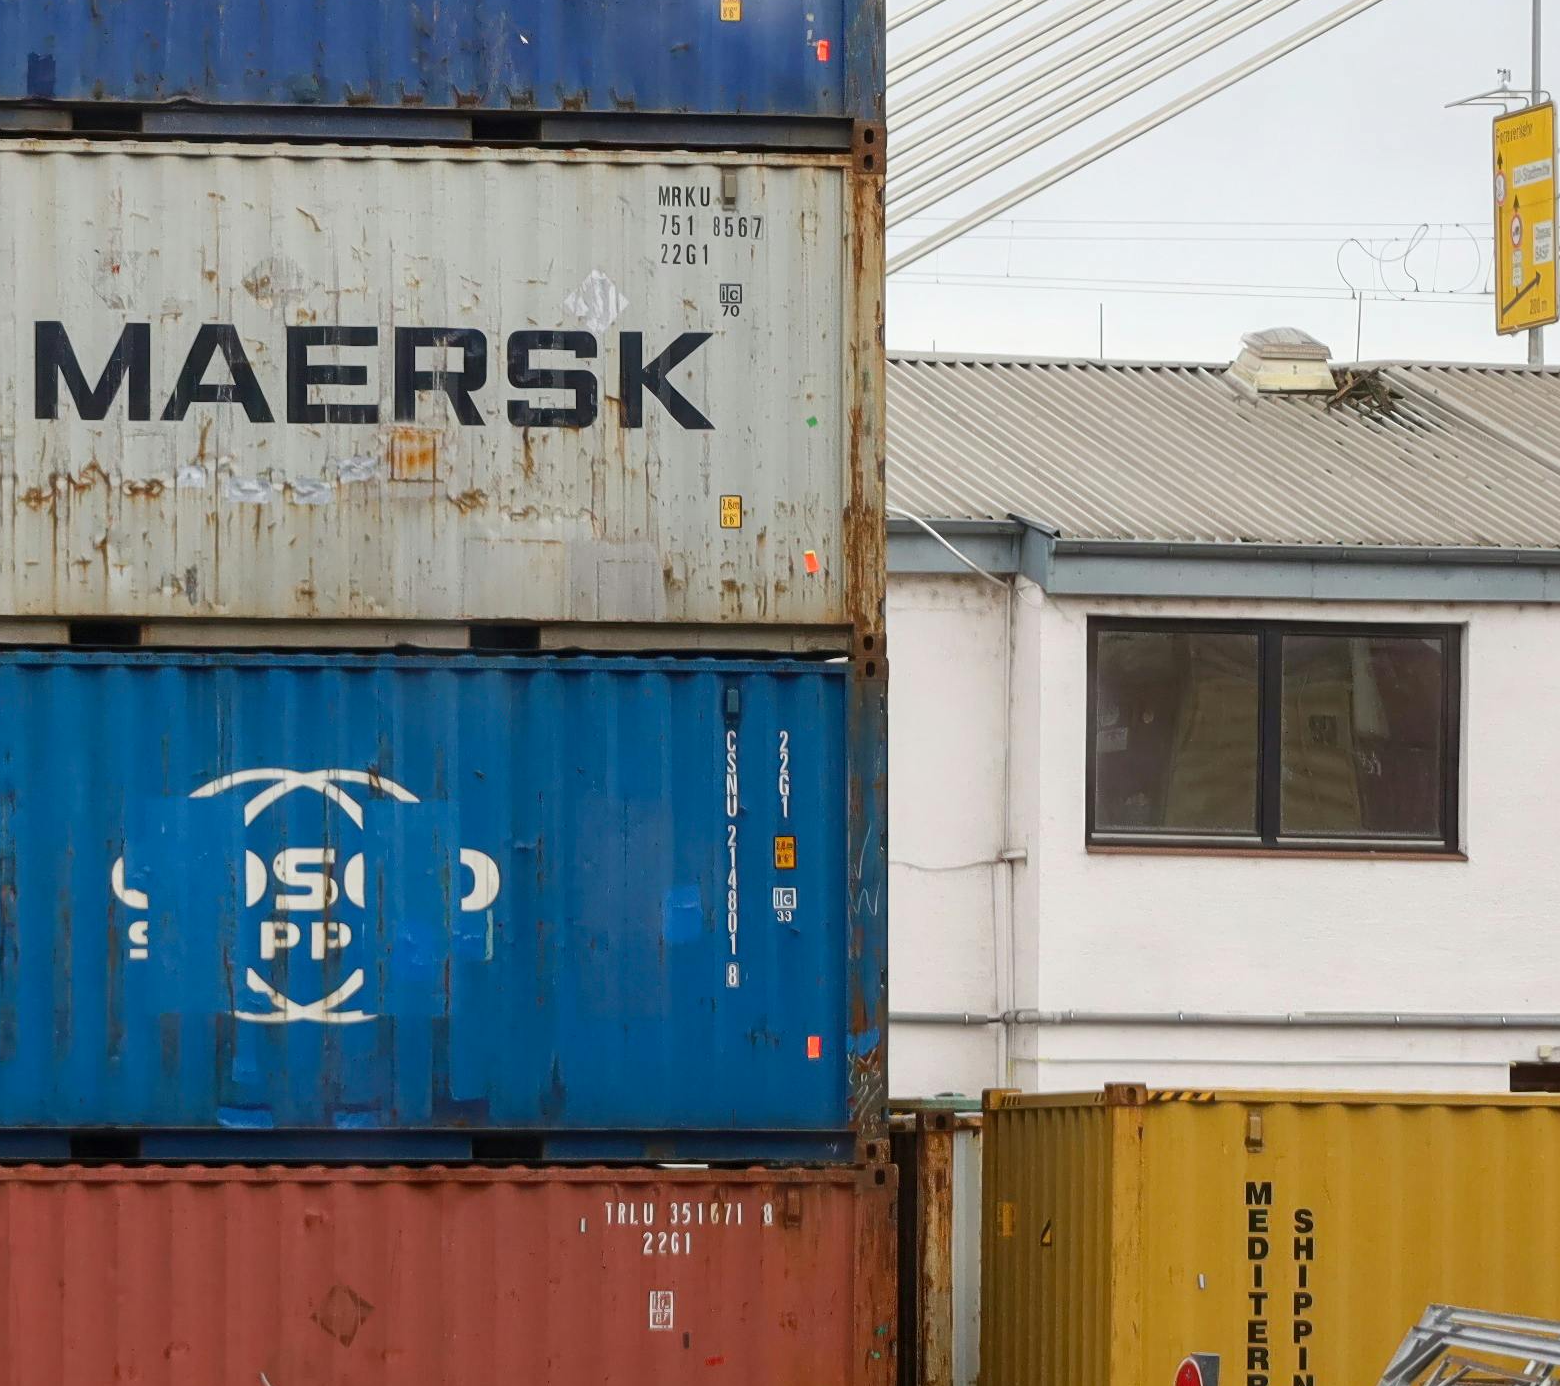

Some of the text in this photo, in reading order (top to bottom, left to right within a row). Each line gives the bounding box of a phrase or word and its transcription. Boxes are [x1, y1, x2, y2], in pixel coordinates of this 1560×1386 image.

[658, 186, 710, 207] MRKU
[660, 214, 694, 236] 751
[660, 243, 708, 266] 22G1
[721, 305, 740, 317] 70
[32, 320, 716, 432] MAERSK
[779, 730, 791, 818] 22G1
[726, 730, 738, 986] CSNU 214801 8
[605, 1202, 653, 1225] TRLU
[762, 1202, 774, 1226] 8
[643, 1232, 691, 1255] 22G1
